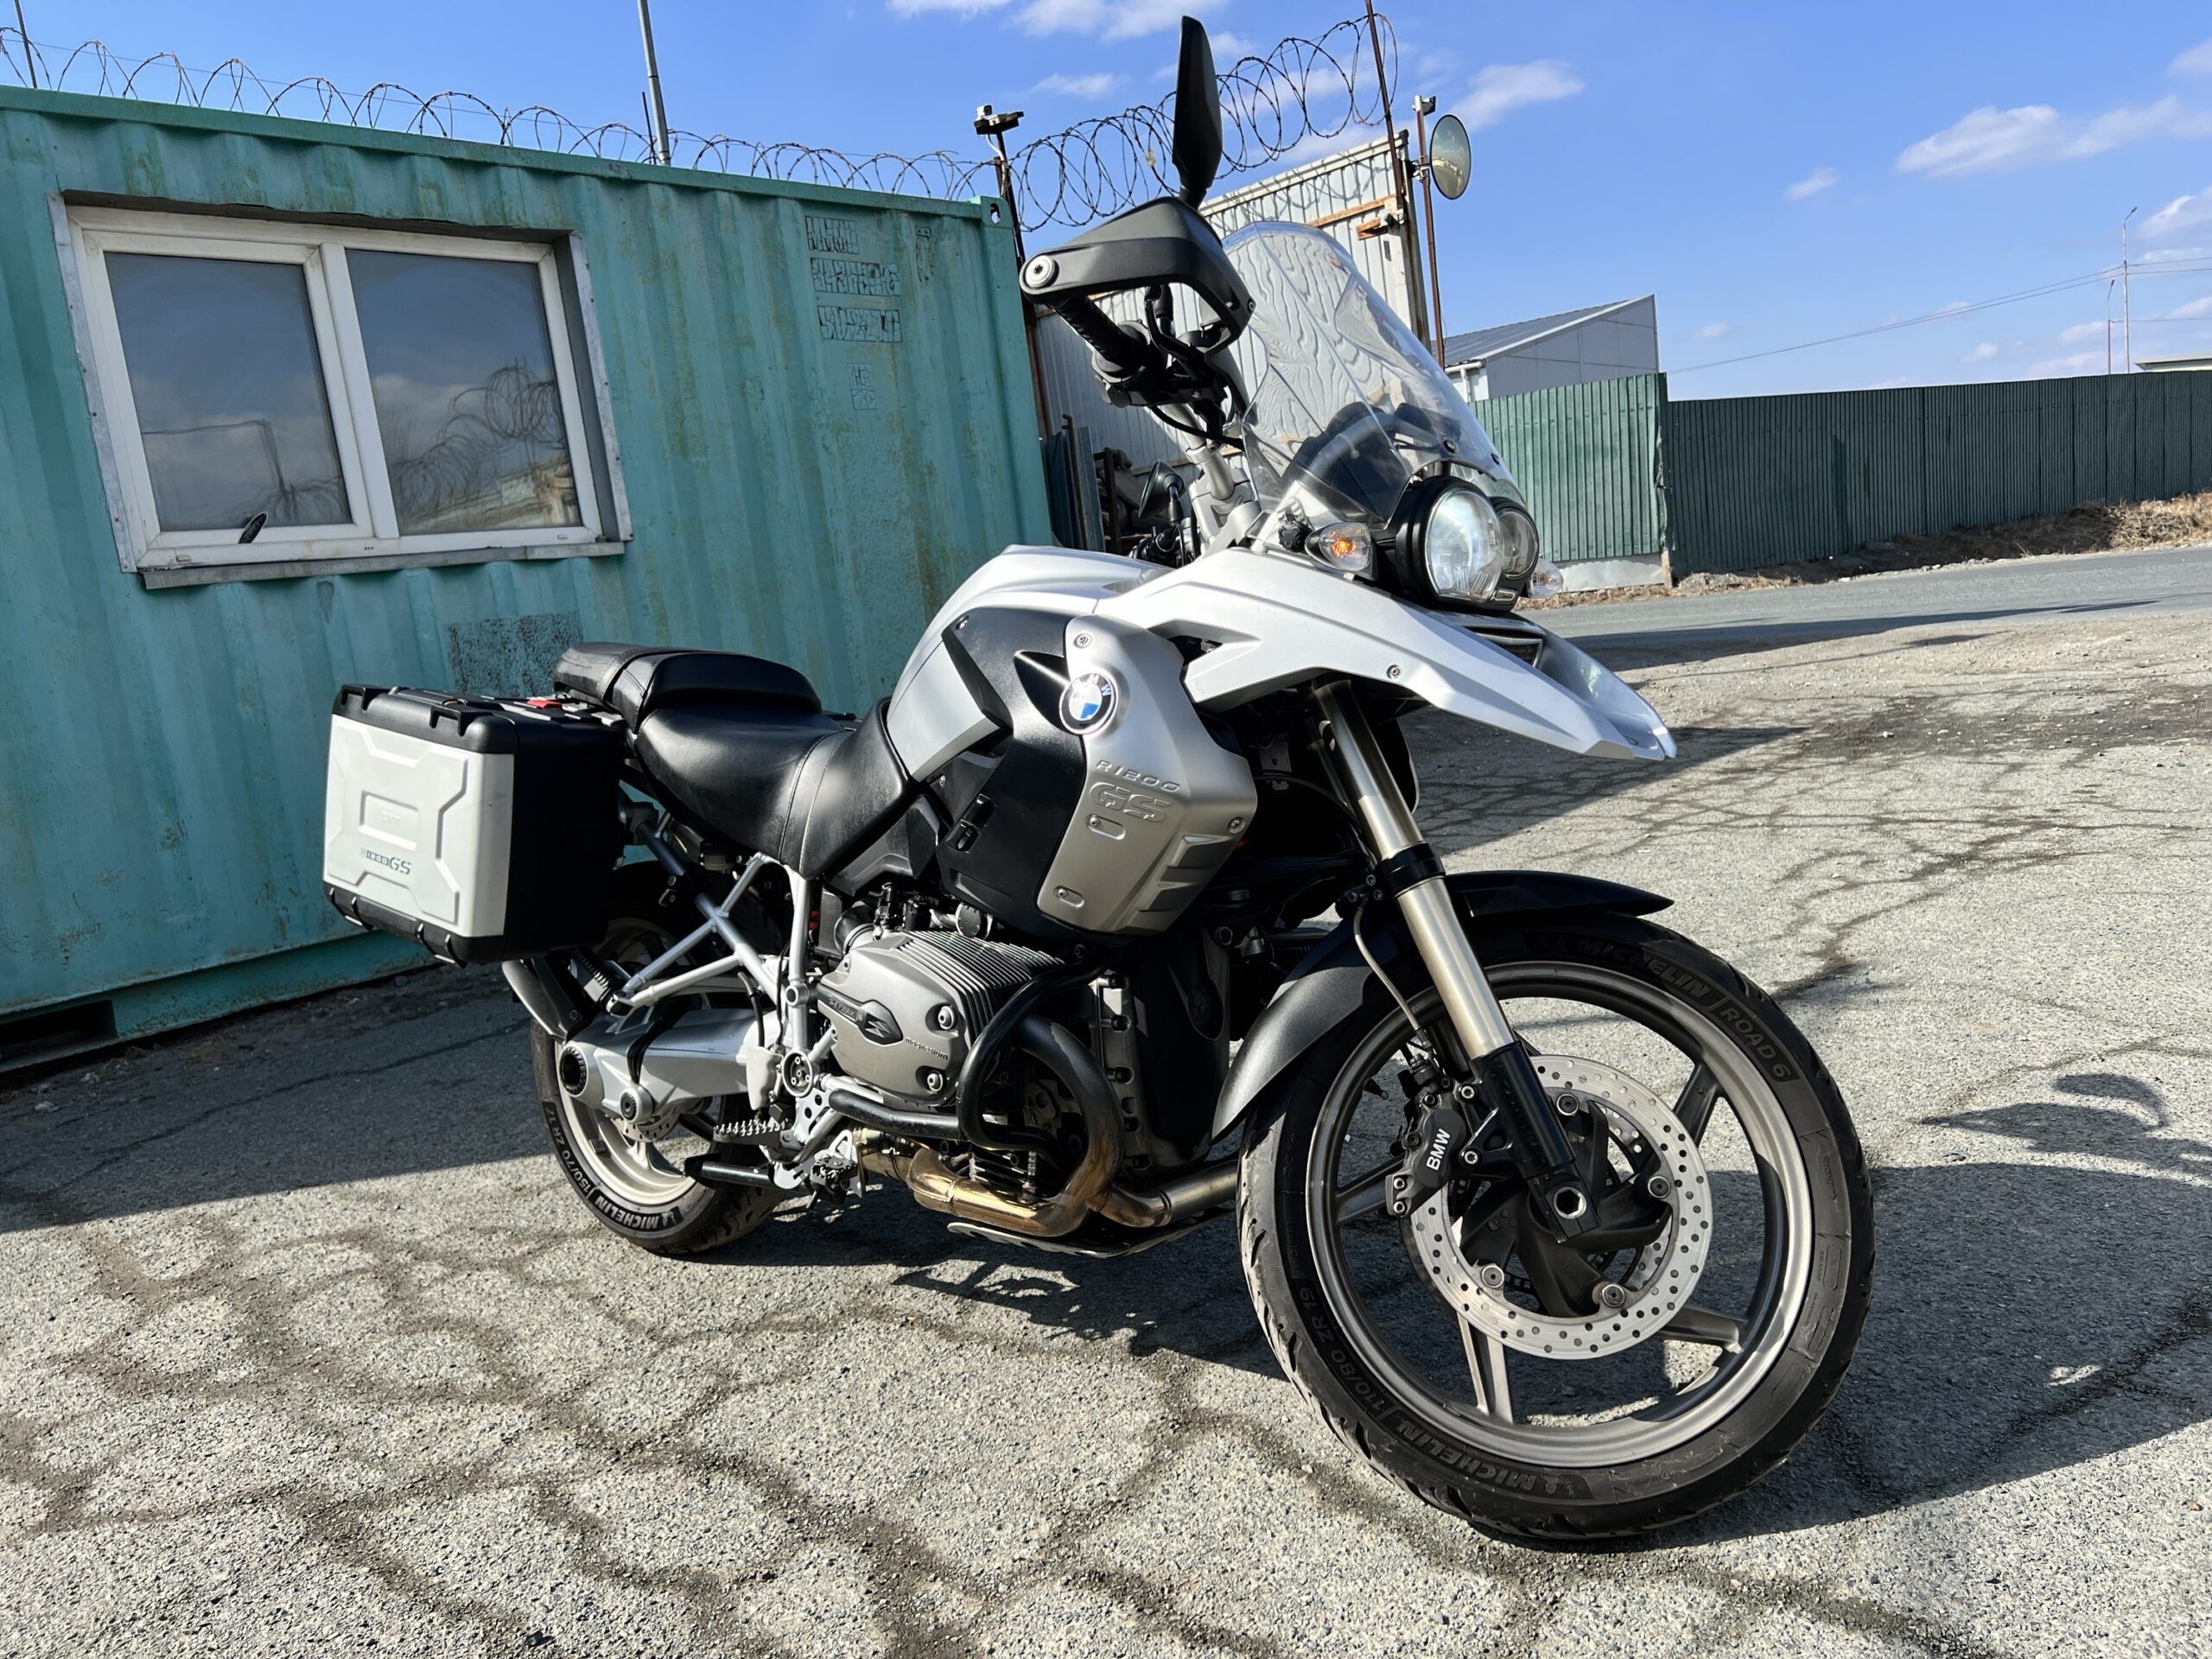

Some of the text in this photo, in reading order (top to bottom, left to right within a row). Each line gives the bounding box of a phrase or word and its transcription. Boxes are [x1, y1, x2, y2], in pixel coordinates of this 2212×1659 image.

[1096, 760, 1181, 793] R1200
[1089, 781, 1173, 823] GS
[1720, 1007, 1777, 1059] ROAD
[1772, 1063, 1791, 1077] 6
[552, 1126, 566, 1147] ZR
[1426, 1128, 1451, 1171] BMW
[562, 1150, 592, 1195] 150/70
[594, 1194, 659, 1230] MICHELIN
[1299, 1286, 1537, 1491] MICHELIN 110/80 ZR 19
